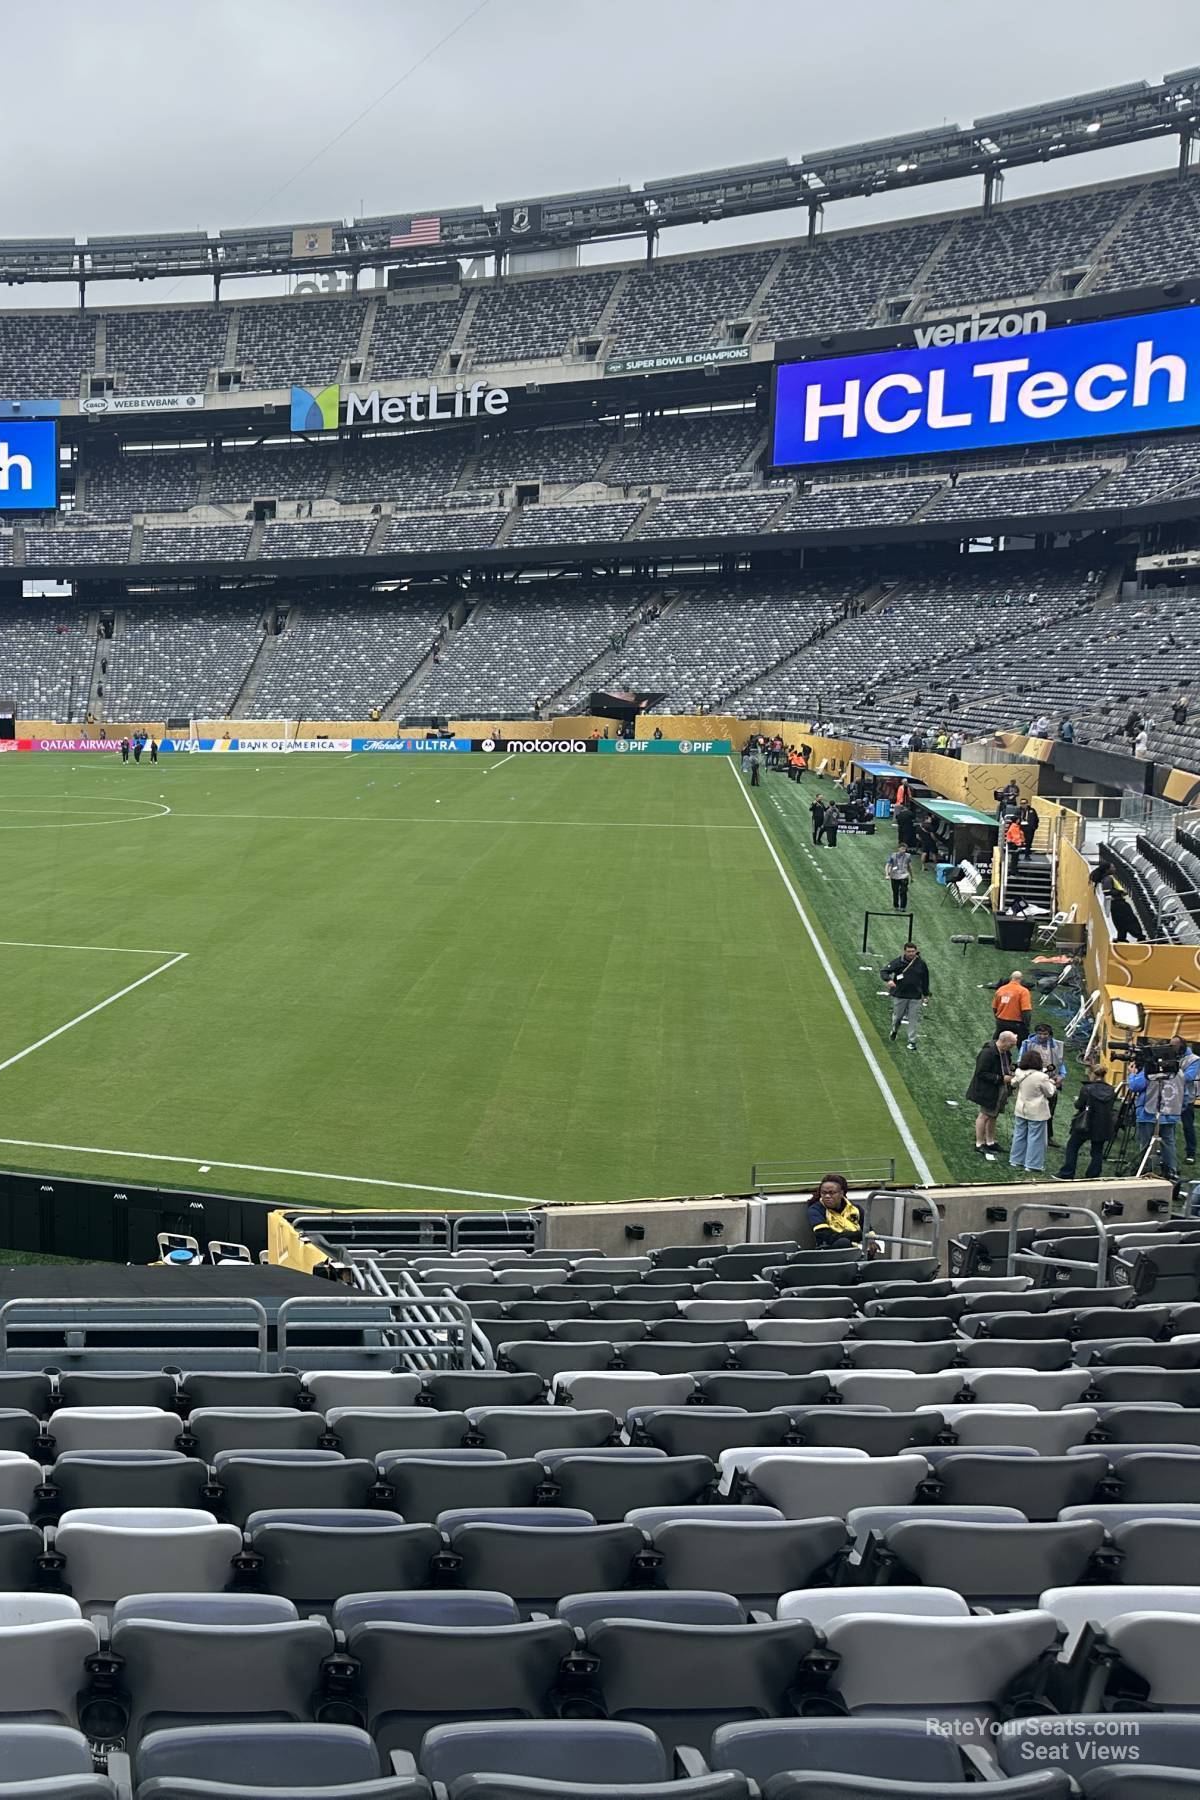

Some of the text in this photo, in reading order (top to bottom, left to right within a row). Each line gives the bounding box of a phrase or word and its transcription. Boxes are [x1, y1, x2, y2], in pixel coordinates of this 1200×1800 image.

[914, 309, 1047, 350] verizon
[626, 359, 655, 370] SUPER
[656, 356, 685, 367] BOWL
[694, 348, 749, 362] CHAMPIONS
[804, 340, 1188, 443] HCLTech
[141, 399, 179, 407] EWBANK
[346, 379, 510, 426] MetLife
[40, 740, 122, 750] QATAR AIRWAYS
[173, 740, 200, 751] VISA
[240, 741, 335, 749] BANK OF AMERICA
[416, 741, 456, 750] ULTRA
[507, 739, 586, 752] motorola
[629, 742, 648, 750] PIF
[693, 742, 712, 750] PIF
